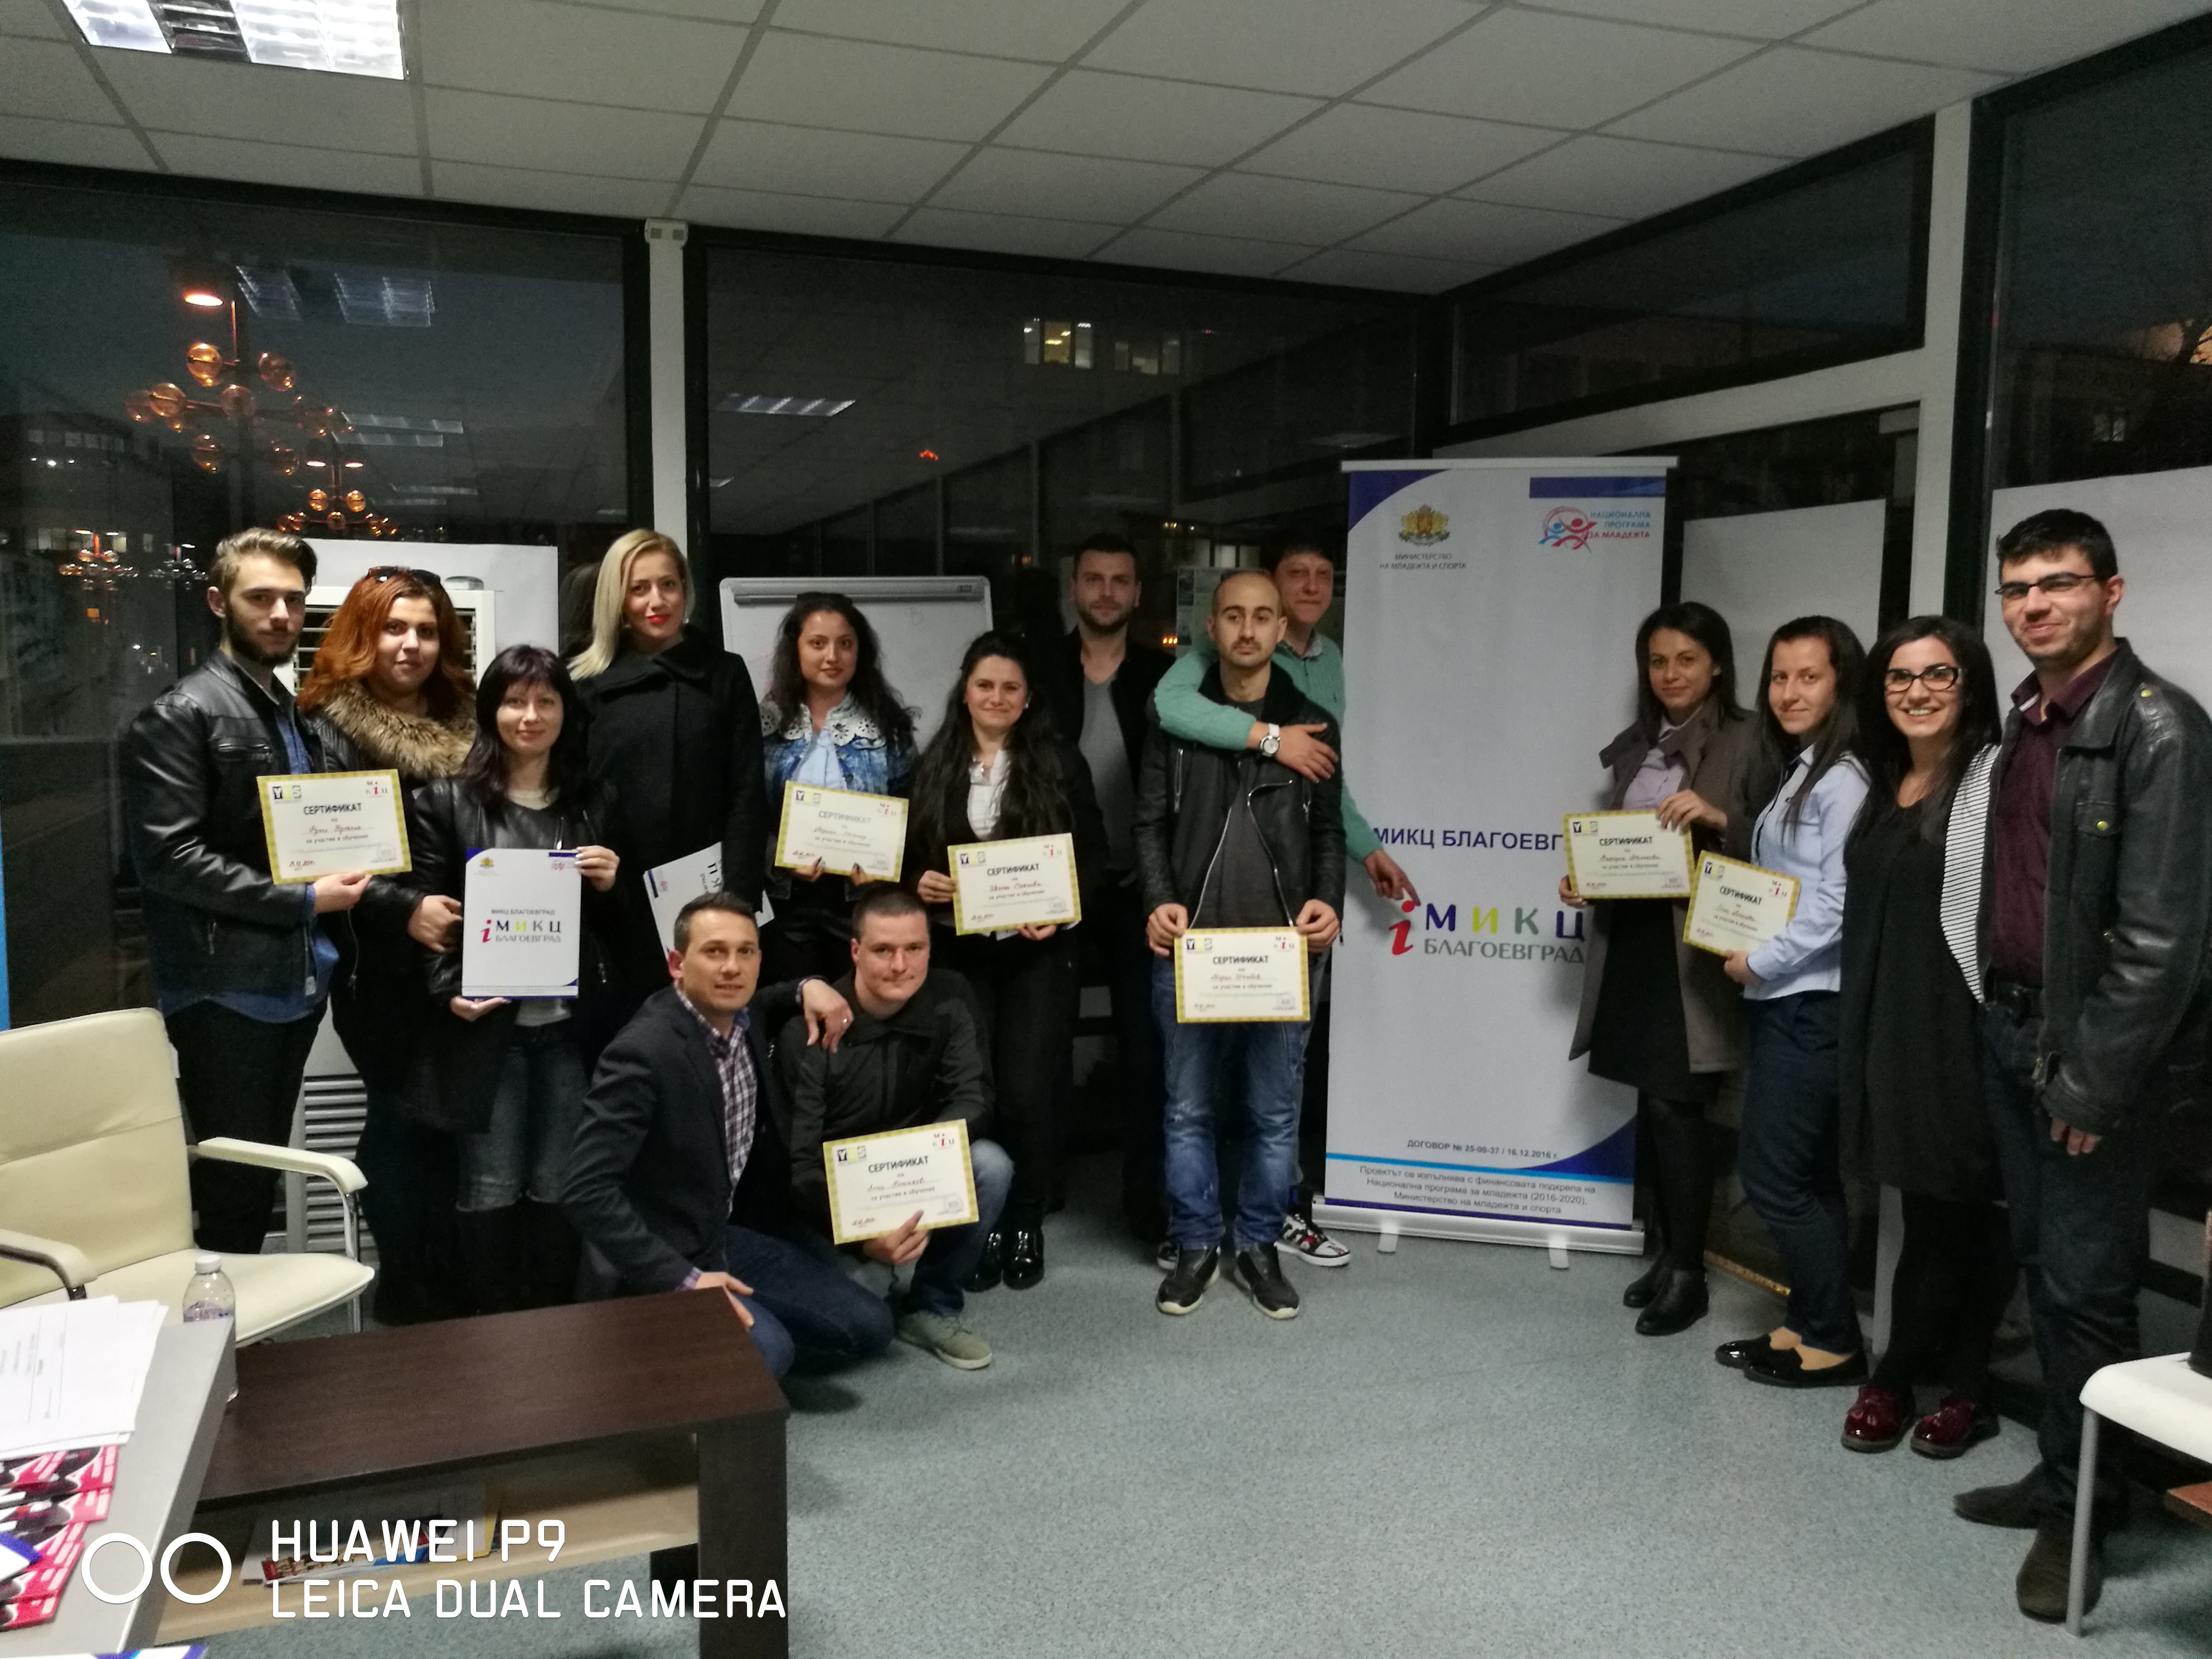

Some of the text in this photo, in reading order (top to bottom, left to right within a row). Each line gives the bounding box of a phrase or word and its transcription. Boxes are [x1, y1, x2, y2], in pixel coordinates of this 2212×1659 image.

[303, 803, 362, 815] СЕРТИФИКАТ
[819, 811, 871, 824] СЕРТИФИКАТ
[1373, 828, 1564, 851] МИКЦ БЛАГОЕВГ
[987, 863, 1040, 876] СЕРТИФИКАТ
[1212, 955, 1269, 965] СЕРТИФИКАТ
[1424, 938, 1585, 964] БЛАГОЕВГРАД
[1407, 1139, 1450, 1150] ДОГОВОР
[1464, 1144, 1499, 1154] 25-00-37
[1507, 1148, 1551, 1159] 16.12.2016
[869, 1156, 929, 1173] СЕРТИФИКАТ
[1360, 1165, 1402, 1177] Проектът
[1417, 1172, 1465, 1182] изпълнява
[1475, 1176, 1536, 1189] финансовата
[1539, 1183, 1582, 1193] подкрепа
[1366, 1177, 1422, 1190] Национална
[1424, 1183, 1467, 1194] програма
[1482, 1190, 1528, 1200] младежта
[1394, 1191, 1457, 1205] Министерство
[1474, 1200, 1519, 1210] младежта
[1530, 1204, 1561, 1214] спорта
